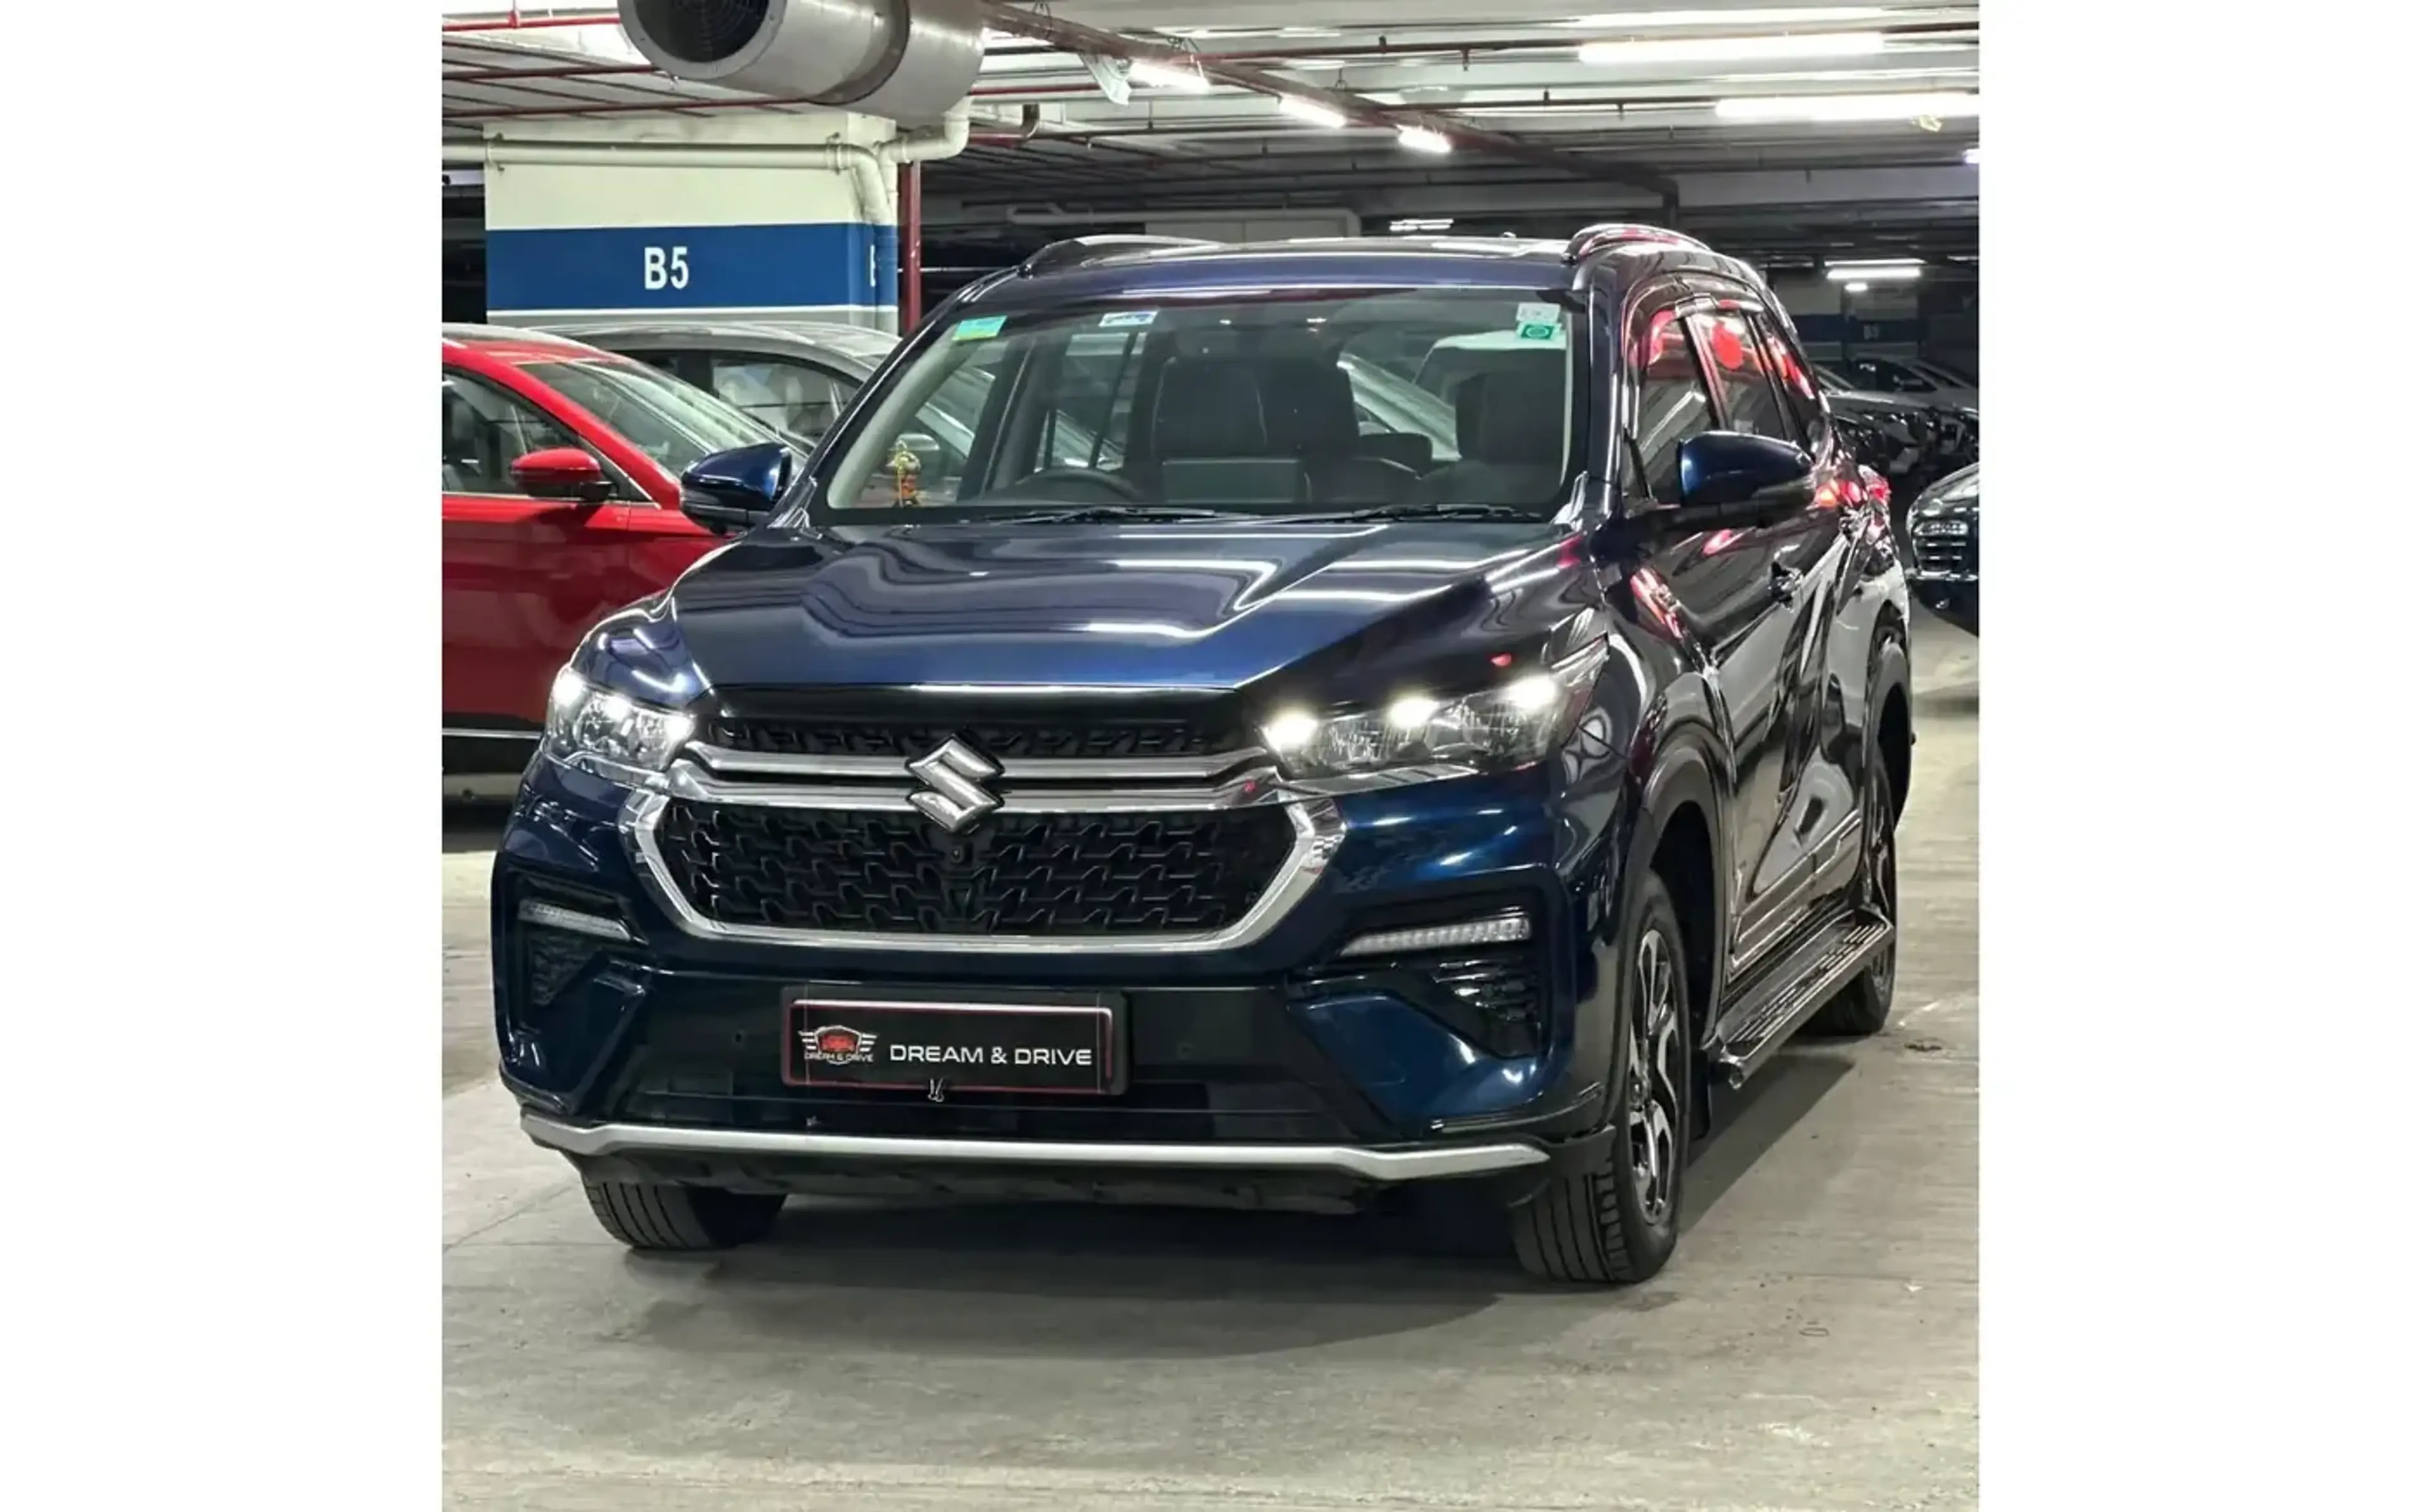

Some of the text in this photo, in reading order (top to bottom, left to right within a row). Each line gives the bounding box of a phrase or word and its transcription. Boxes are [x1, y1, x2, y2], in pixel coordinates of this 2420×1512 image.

[644, 246, 689, 290] B5
[890, 1044, 1092, 1065] DREAM & DRIVE
